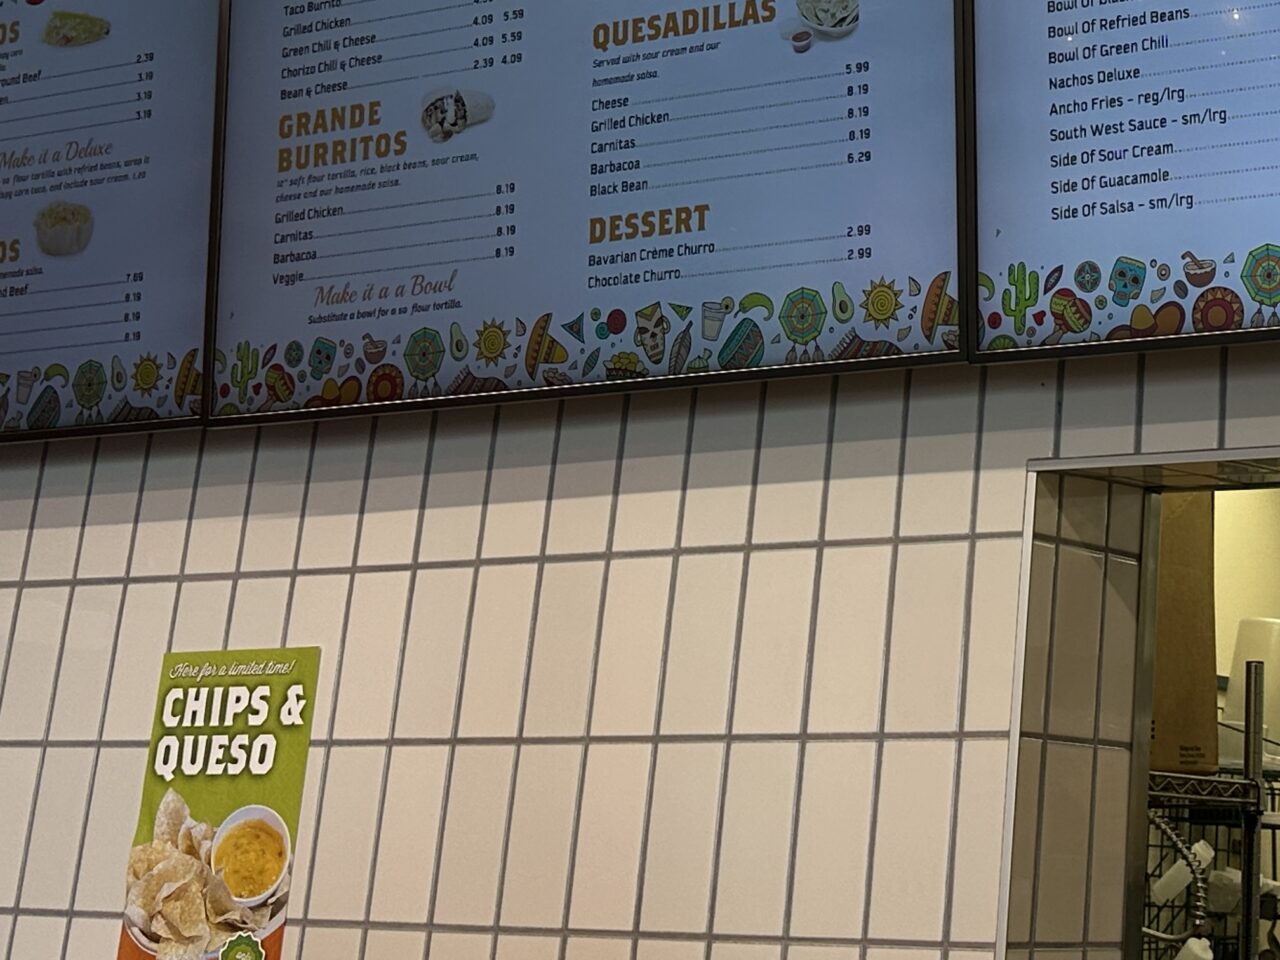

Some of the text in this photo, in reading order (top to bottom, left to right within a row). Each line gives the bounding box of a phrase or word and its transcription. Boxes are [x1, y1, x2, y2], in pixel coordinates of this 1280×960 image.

[283, 4, 305, 15] Taco
[282, 22, 313, 37] Grilled
[314, 17, 352, 31] Chicken
[1048, 47, 1079, 64] Bowl
[1082, 44, 1097, 59] Of
[1100, 42, 1137, 56] Green
[1141, 35, 1168, 51] Chili
[591, 60, 869, 111] Cheese 5.99
[1048, 73, 1093, 89] Nachos
[1097, 68, 1140, 83] Deluxe
[591, 83, 868, 132] Grilled Chicken 8.19
[1049, 99, 1087, 115] Ancho
[1091, 95, 1123, 110] Fries
[1137, 87, 1184, 105] reg/lrg
[278, 101, 381, 138] GRANDE
[278, 130, 406, 171] BURRITOS
[589, 150, 871, 196] Black Bean 6.29
[1050, 179, 1077, 194] Side
[1080, 177, 1097, 192] Of
[1099, 167, 1170, 189] Guacamole
[274, 206, 345, 223] Grilled Chicken
[589, 204, 709, 243] DESSERT
[273, 230, 316, 244] Carnitas
[588, 224, 872, 266] Bavarian Crème Churro 2.99
[273, 250, 319, 264] Barbacoa
[587, 247, 872, 288] Chocolate Churro 2.99
[272, 271, 306, 286] Veggie
[314, 269, 457, 306] Make it a a Bowl
[169, 659, 296, 682] Here for a limited time!
[162, 684, 307, 728] CHIPS &
[154, 734, 277, 782] QUESO
